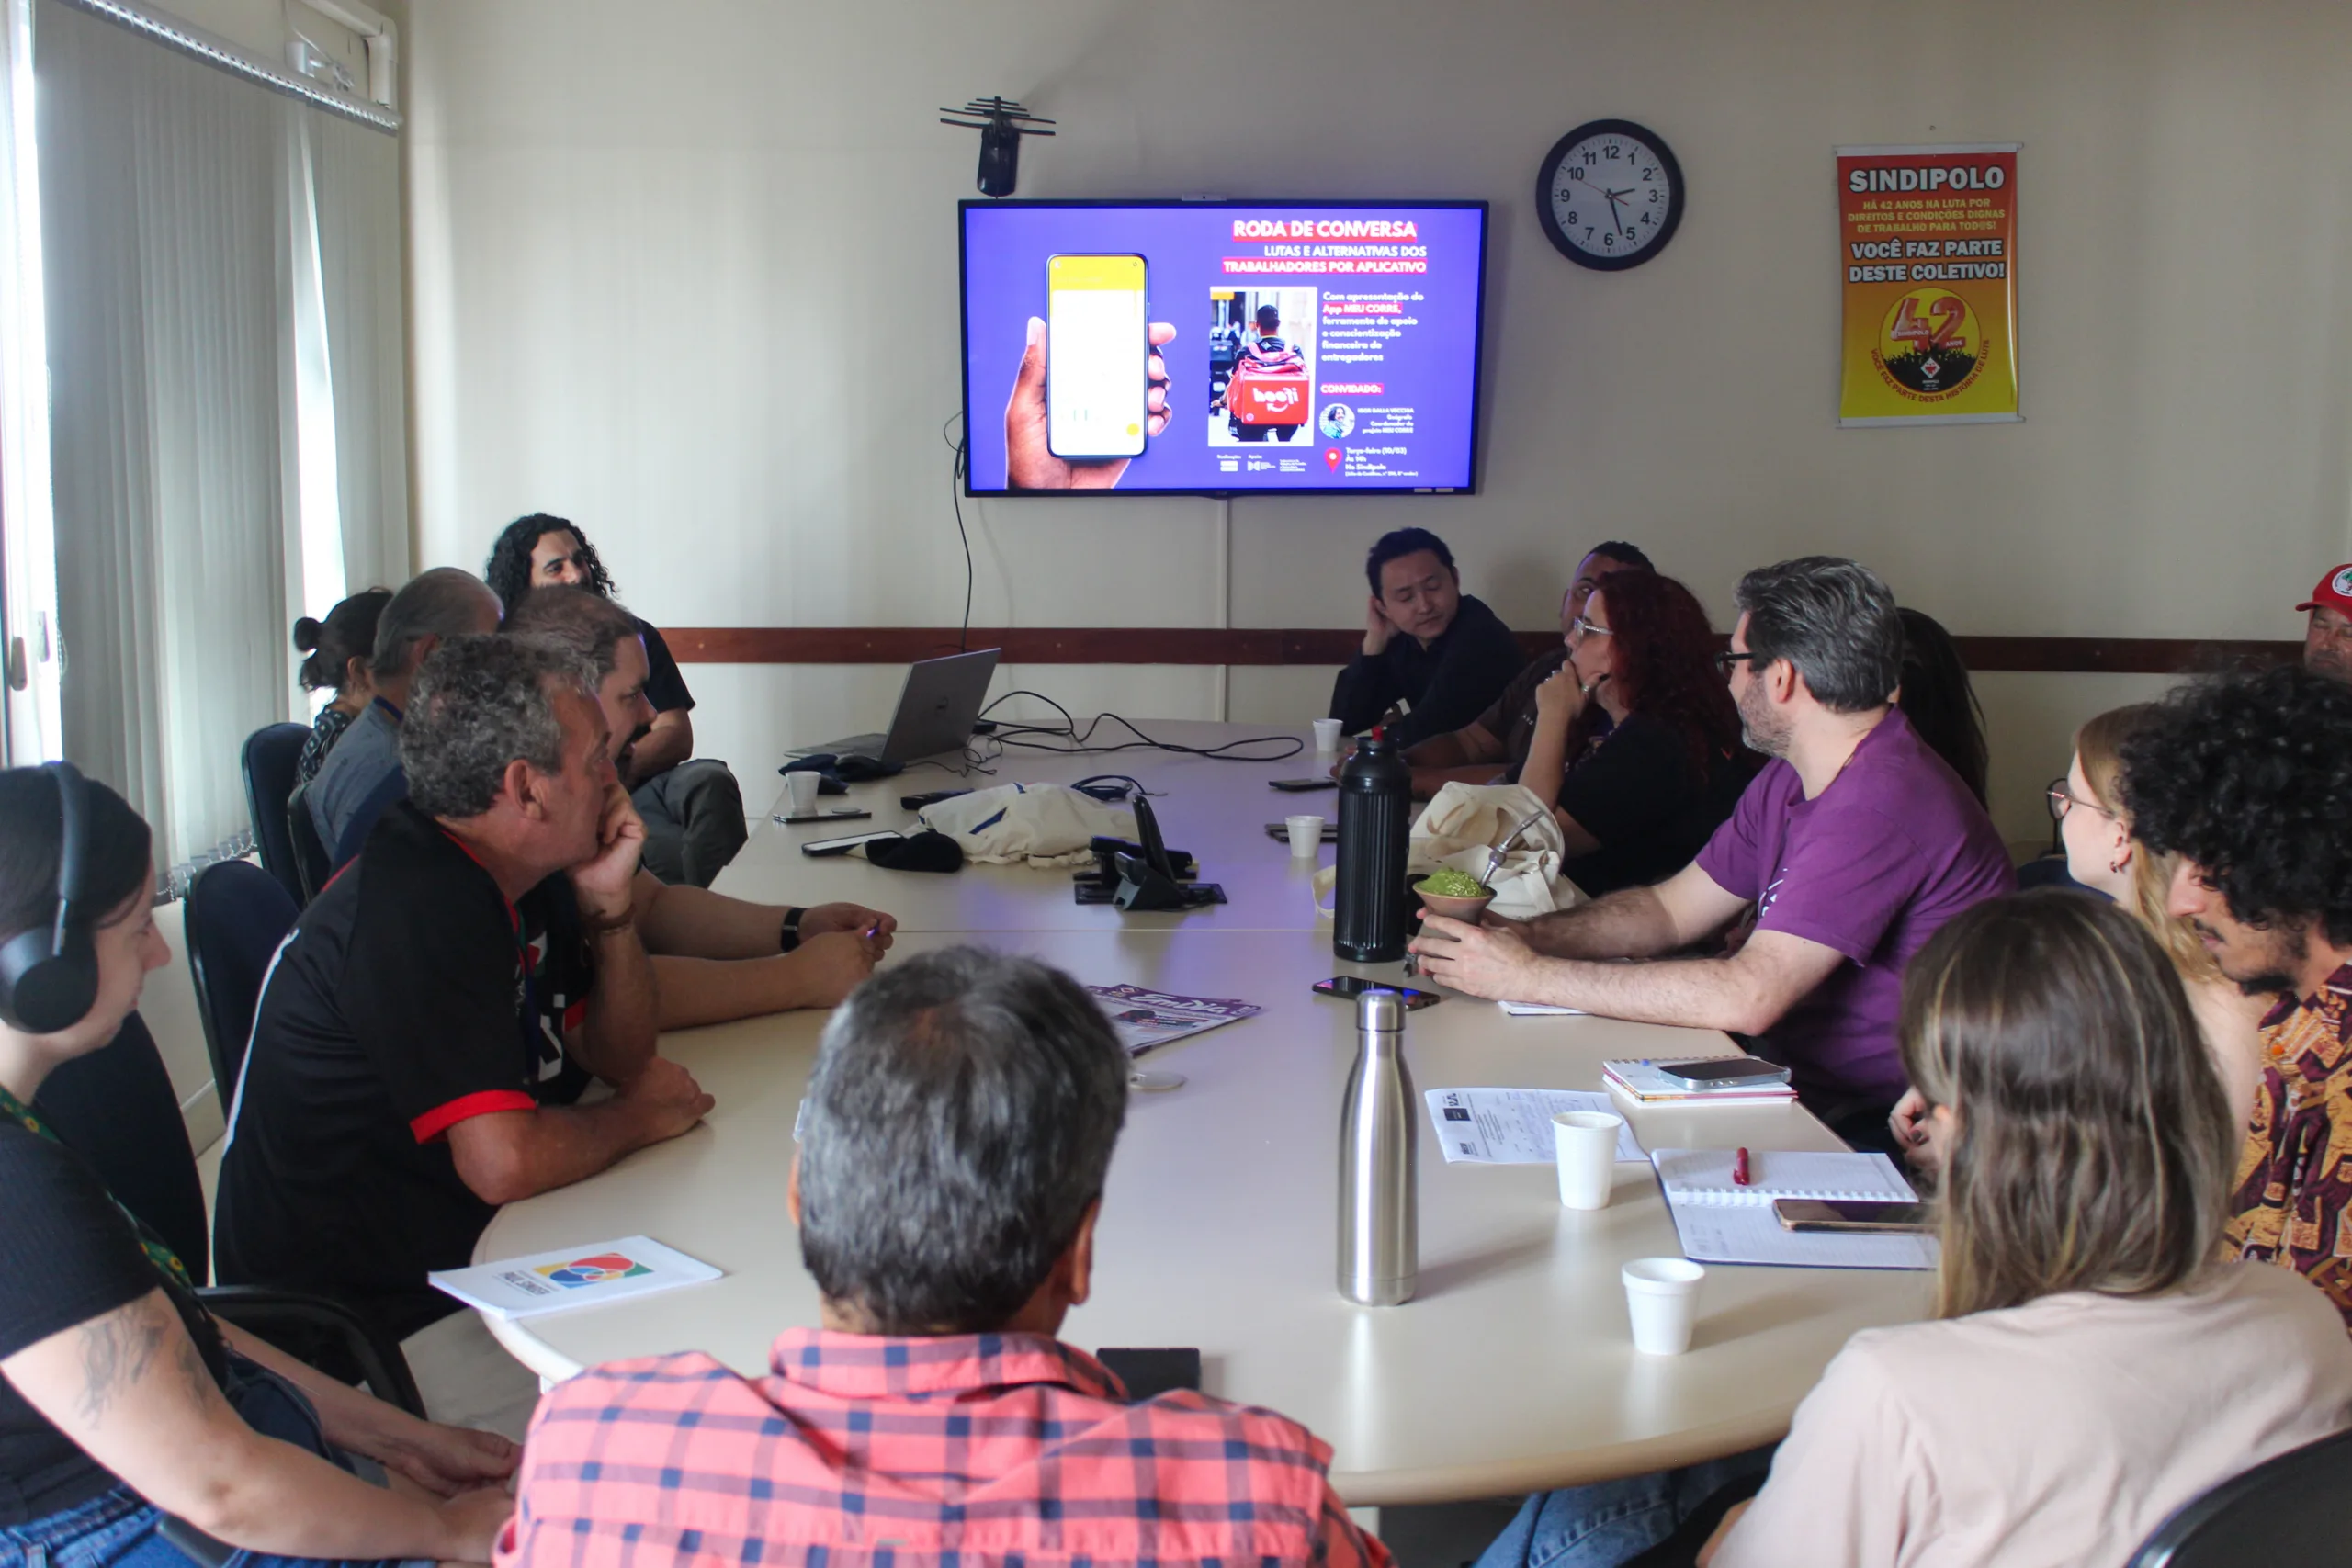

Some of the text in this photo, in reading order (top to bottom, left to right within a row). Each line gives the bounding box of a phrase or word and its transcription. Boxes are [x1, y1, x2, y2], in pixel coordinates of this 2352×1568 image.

[1582, 152, 1597, 165] 11
[1603, 146, 1620, 159] 12
[1628, 152, 1635, 165] 1
[1567, 167, 1584, 180] 10
[1642, 168, 1652, 181] 2
[1849, 166, 2005, 192] SINDIPOLO
[1561, 189, 1570, 202] 9
[1648, 189, 1658, 203] 3
[1863, 198, 1991, 210] HÁ 42 ANOS NA LUTA POR
[1568, 211, 1577, 225] 8
[1640, 212, 1650, 225] 4
[1848, 209, 2006, 221] DIREITOS E CONDIÇÕES DIGNAS
[1233, 220, 1418, 238] RODA DE CONVERSA
[1585, 227, 1594, 240] 7
[1626, 227, 1635, 240] 5
[1857, 224, 1871, 233] DE
[1873, 223, 1928, 232] TRABALHO
[1929, 222, 1957, 231] PARA
[1604, 233, 1613, 246] 6
[1264, 246, 1427, 257] LUTAS E ALTERNATIVAS DOS
[1851, 236, 2003, 259] VOCÊ FAZ PARTE
[1224, 261, 1426, 273] TRABALHADORES POR APLICATIVO
[1849, 262, 2007, 282] DESTE COLETIVO!
[1323, 292, 1345, 301] Com
[1346, 292, 1410, 303] apresentação
[1323, 304, 1402, 315] App MEU CORRE,
[1322, 316, 1375, 325] ferramenta
[1390, 316, 1418, 327] apoio
[1891, 296, 1966, 351] 42
[1329, 328, 1402, 339] conscientização
[1322, 340, 1369, 349] financeira
[1945, 340, 1963, 348] ANOS
[1321, 352, 1384, 363] entregadores
[1880, 371, 1894, 387] FAZ
[1892, 382, 1917, 401] PARTE
[1918, 394, 1945, 403] DESTA
[1976, 359, 1986, 372] DE
[1981, 339, 1990, 362] LUTA
[1320, 384, 1382, 393] CONVIDADO:
